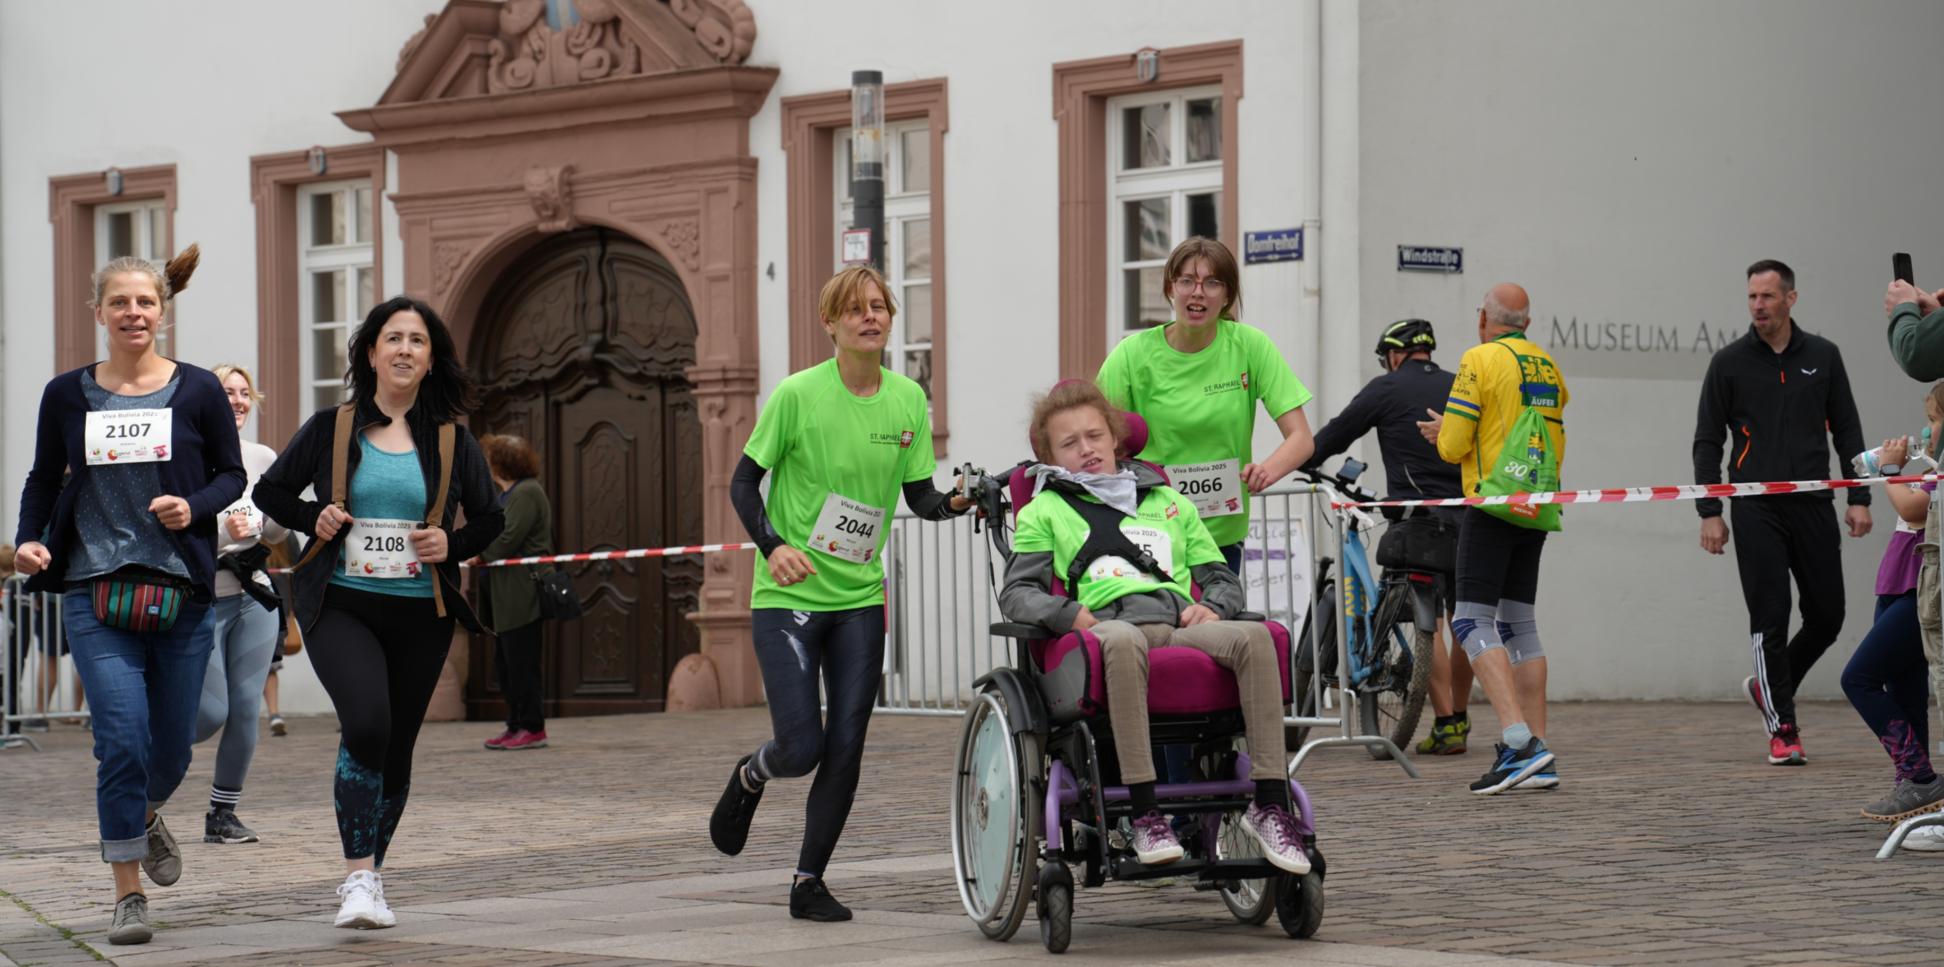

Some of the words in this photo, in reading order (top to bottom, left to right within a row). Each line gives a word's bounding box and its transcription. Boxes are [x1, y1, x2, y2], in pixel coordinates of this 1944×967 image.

[1247, 232, 1300, 254] Domfreihof
[1402, 248, 1459, 264] Windstraße
[766, 261, 776, 282] 4
[105, 422, 152, 439] 2107
[1188, 465, 1210, 473] Bolivia
[1211, 463, 1227, 471] 2025
[1504, 461, 1528, 478] 30
[1178, 477, 1223, 496] 2066
[840, 500, 854, 510] Viva
[374, 521, 396, 529] Bolivia
[835, 514, 875, 539] 2044
[363, 535, 405, 552] 2108
